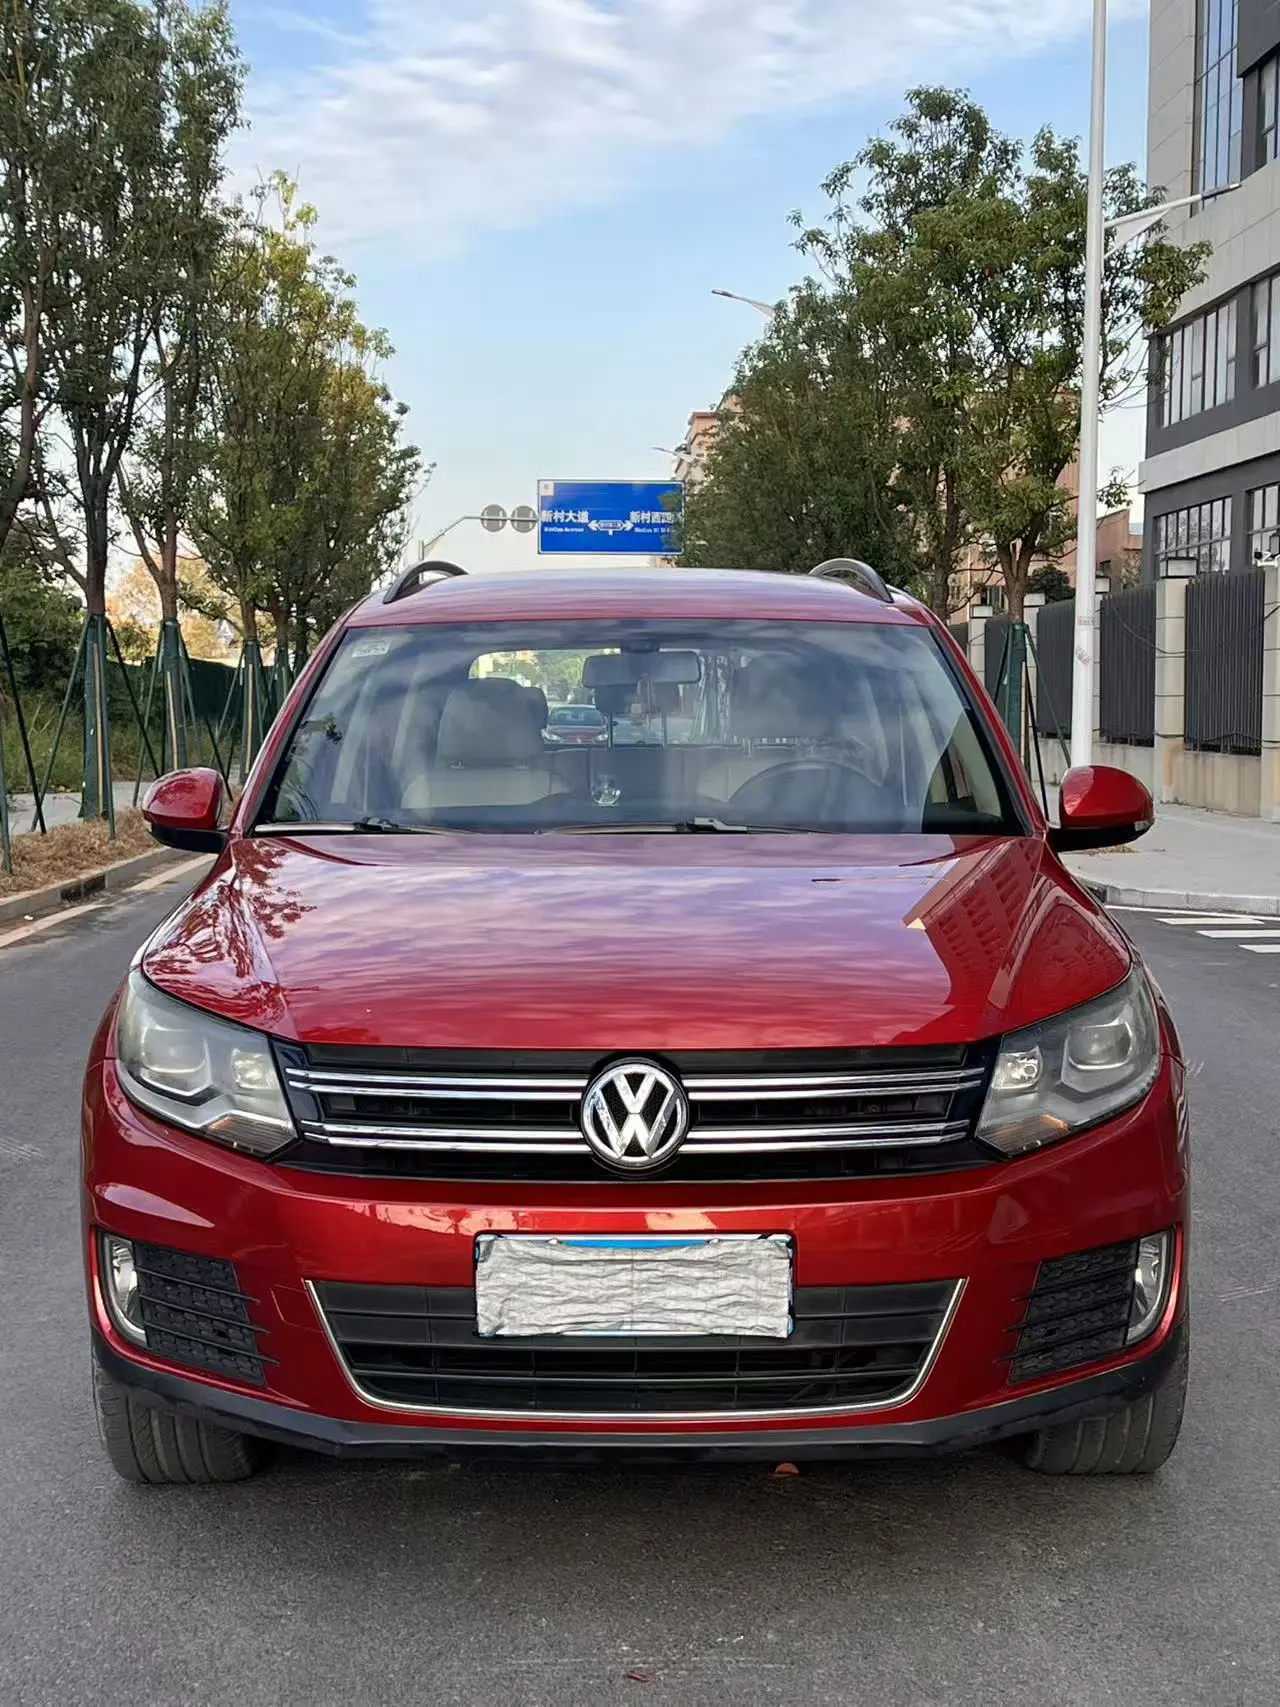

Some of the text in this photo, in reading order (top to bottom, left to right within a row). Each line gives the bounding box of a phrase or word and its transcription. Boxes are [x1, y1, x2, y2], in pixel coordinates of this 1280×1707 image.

[541, 510, 589, 523] 新村大道
[630, 511, 682, 524] 新村西四
